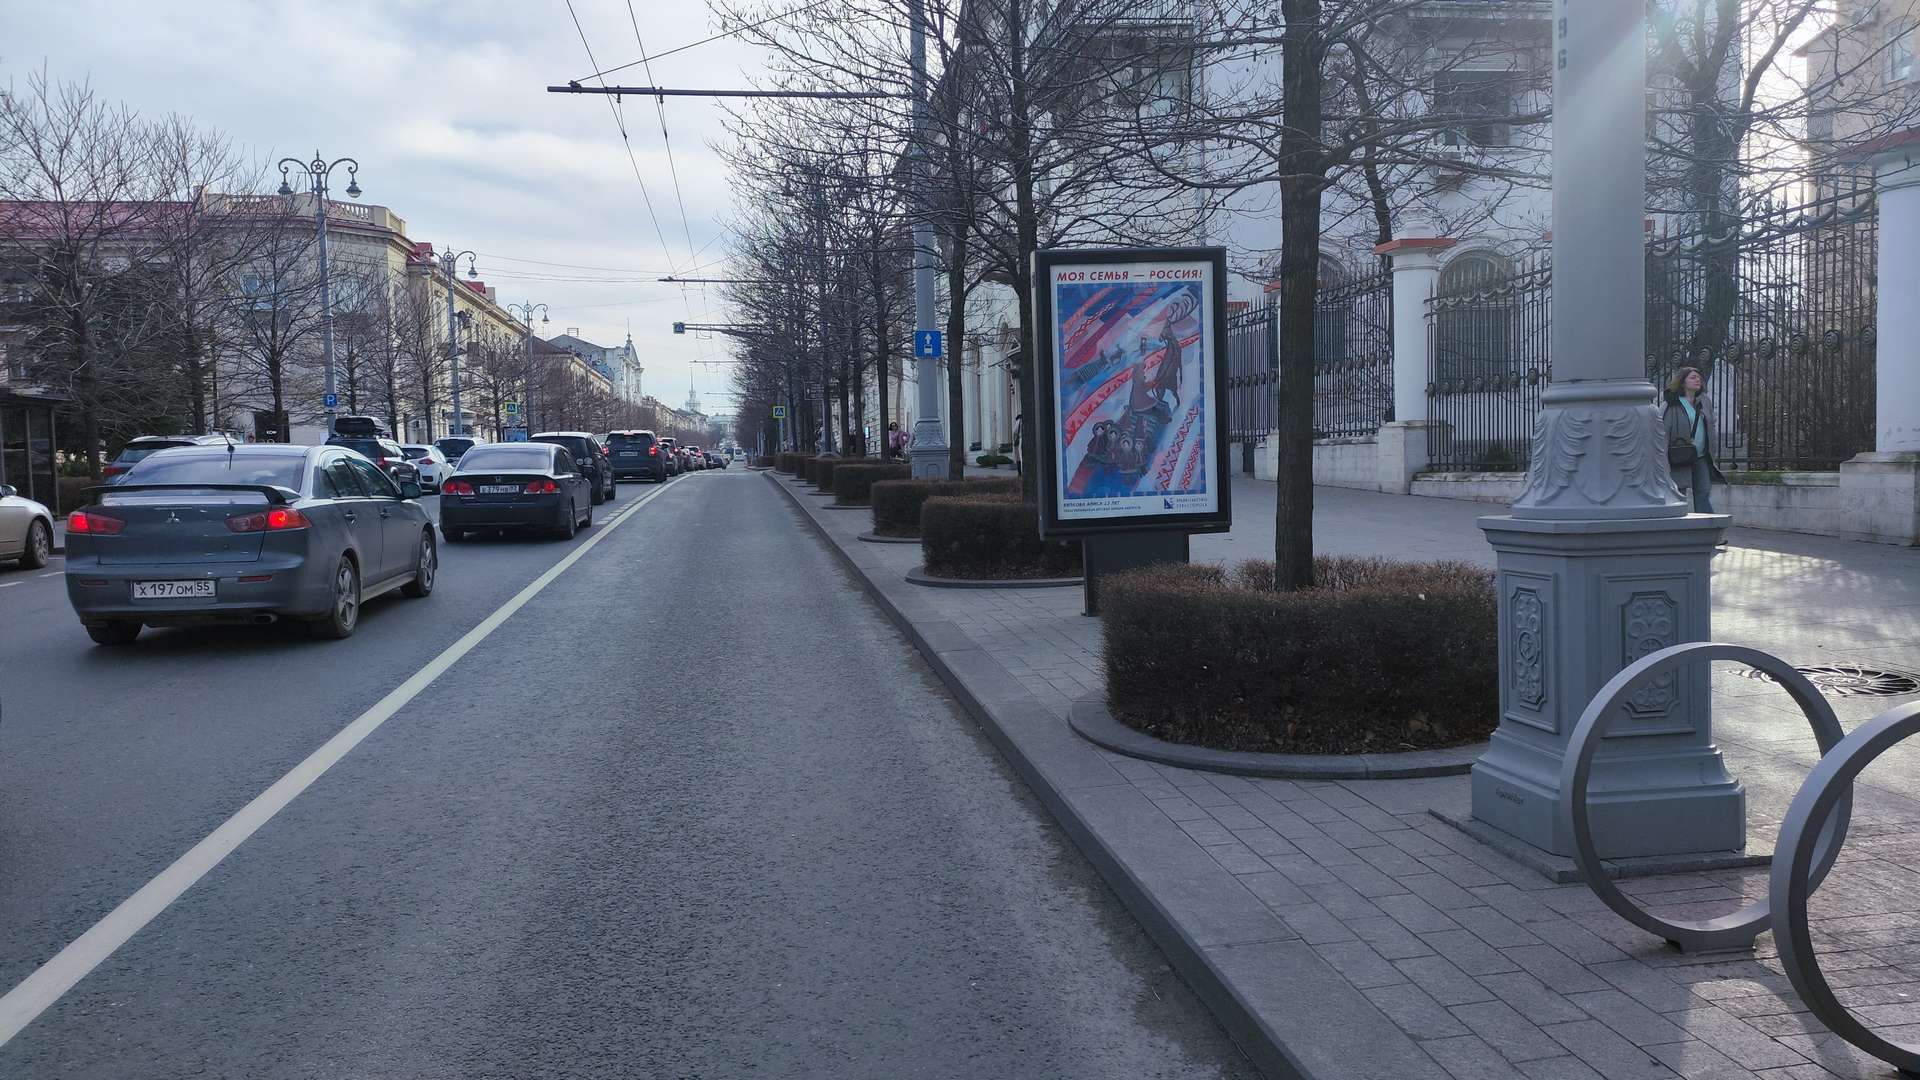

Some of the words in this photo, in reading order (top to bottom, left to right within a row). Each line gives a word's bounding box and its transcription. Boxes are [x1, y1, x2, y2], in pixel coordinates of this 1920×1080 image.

[1057, 272, 1085, 281] МОЯ
[1090, 271, 1129, 281] СЕМЬЯ
[1149, 269, 1203, 280] РОССИЯ!
[326, 395, 335, 406] P
